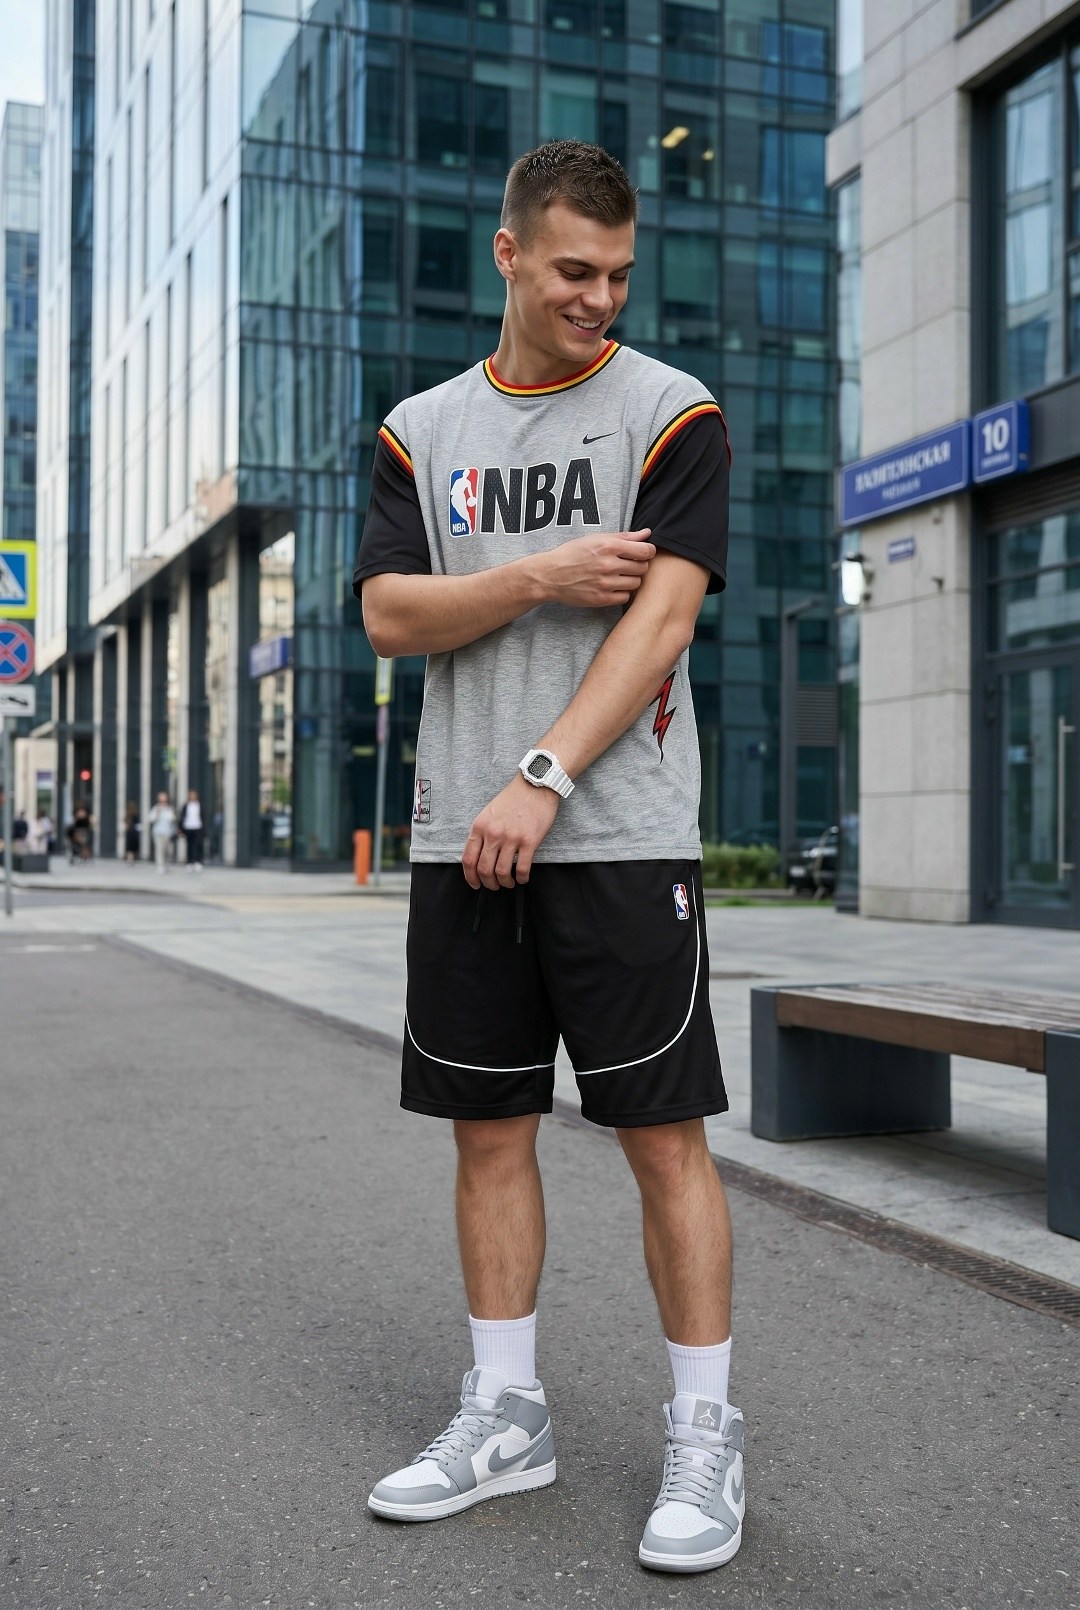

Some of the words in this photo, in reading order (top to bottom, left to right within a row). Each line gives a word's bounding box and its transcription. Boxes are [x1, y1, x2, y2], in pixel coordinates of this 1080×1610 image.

[982, 418, 1009, 454] 10
[480, 457, 601, 535] NBA
[452, 522, 467, 533] NBA
